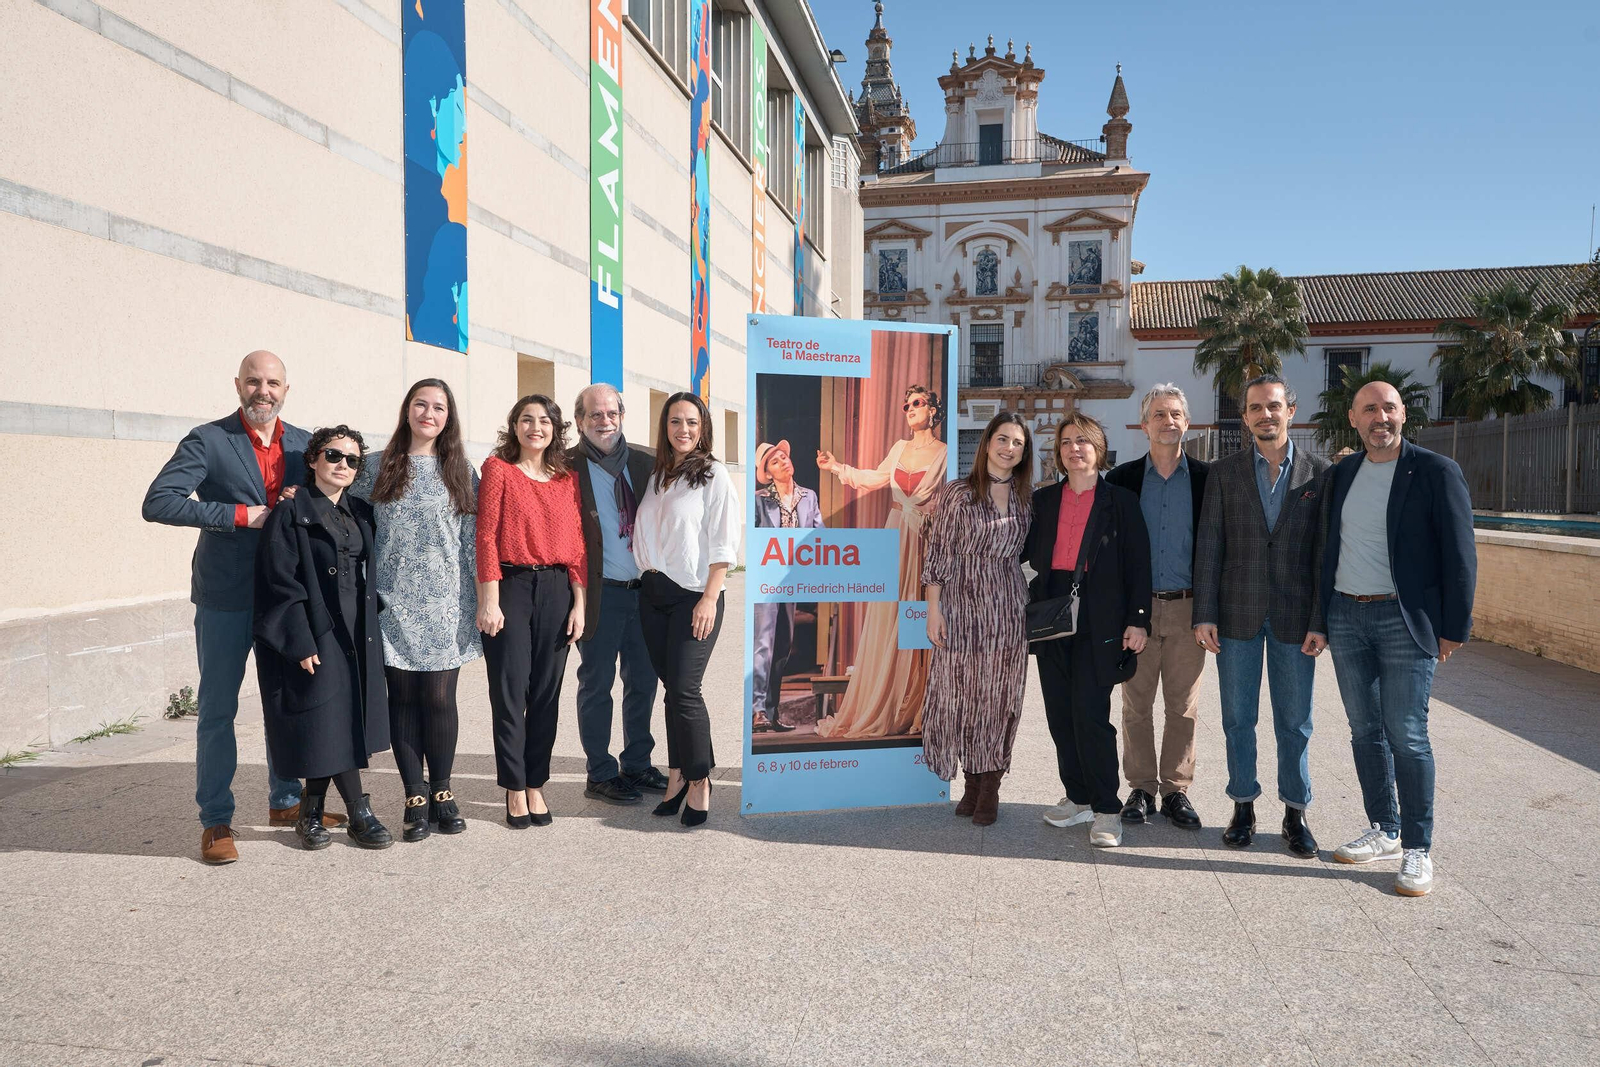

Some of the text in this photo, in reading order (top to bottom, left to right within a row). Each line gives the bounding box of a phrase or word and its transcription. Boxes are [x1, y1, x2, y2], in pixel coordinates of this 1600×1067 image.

[755, 59, 765, 314] NCIERTOS
[766, 337, 820, 350] Teatro de
[782, 350, 861, 363] la Maestranza
[760, 537, 860, 566] Alcina
[760, 582, 885, 596] Georg Friedrich Händel
[905, 606, 927, 621] Ópe
[757, 758, 859, 774] 6, 8 y 10 de febrero
[914, 754, 926, 765] 20
